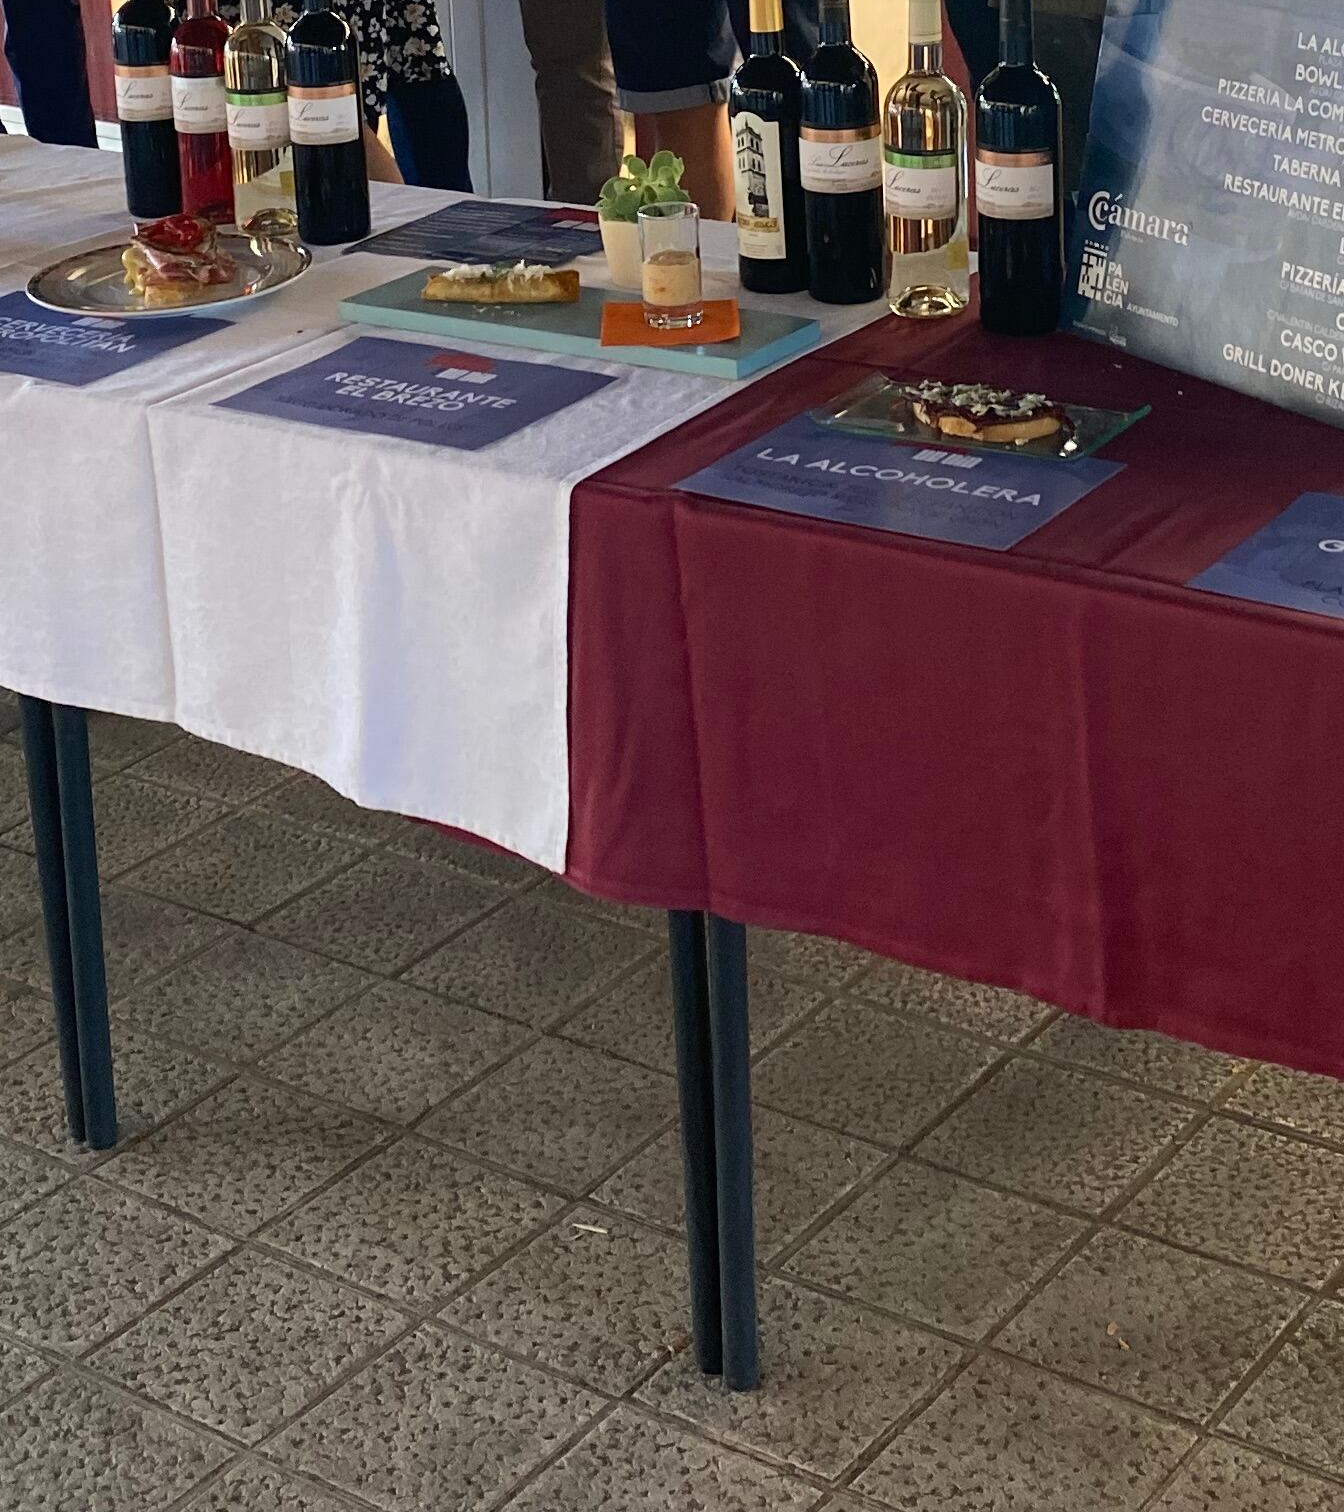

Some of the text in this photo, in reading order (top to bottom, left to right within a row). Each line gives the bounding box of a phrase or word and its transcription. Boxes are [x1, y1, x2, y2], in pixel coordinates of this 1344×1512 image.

[1297, 31, 1319, 51] LA
[1284, 93, 1305, 113] LA
[1272, 153, 1342, 188] TABERNA
[1224, 172, 1329, 217] RESTAURANTE
[1088, 191, 1190, 247] Cámara
[1105, 275, 1129, 295] LEN
[1107, 261, 1123, 278] PA
[1103, 290, 1123, 308] CIA
[1280, 327, 1337, 362] CASCO
[1222, 341, 1268, 373] GRILL
[1269, 357, 1325, 393] DONER
[324, 372, 518, 409] RESTAURANTE
[335, 385, 465, 412] EL BREZO
[755, 448, 800, 465] LA
[805, 458, 1041, 506] ALCOHOLERA
